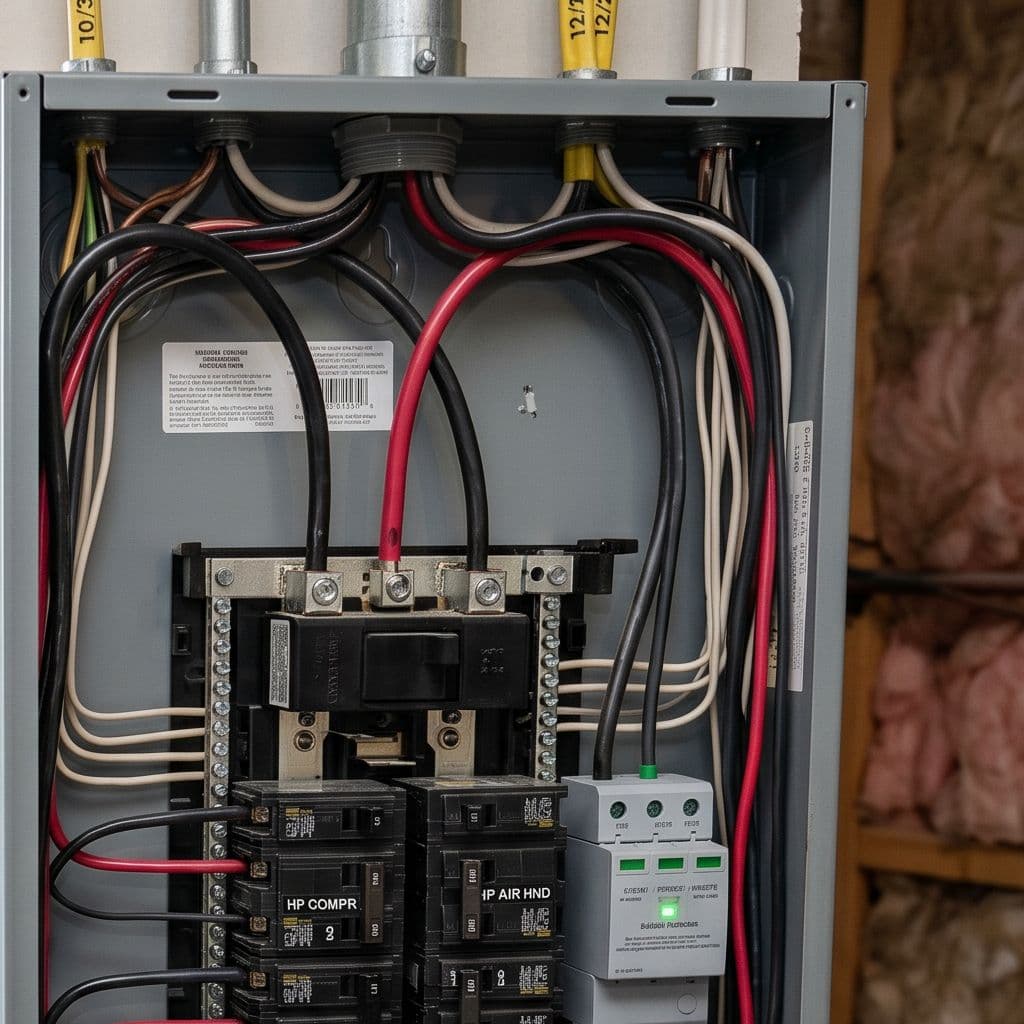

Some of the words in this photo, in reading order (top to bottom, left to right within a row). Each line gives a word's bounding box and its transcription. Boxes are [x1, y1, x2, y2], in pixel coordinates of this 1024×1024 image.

[498, 888, 520, 900] AIR
[523, 887, 551, 899] HND
[287, 899, 304, 911] HP
[307, 898, 357, 910] COMPR
